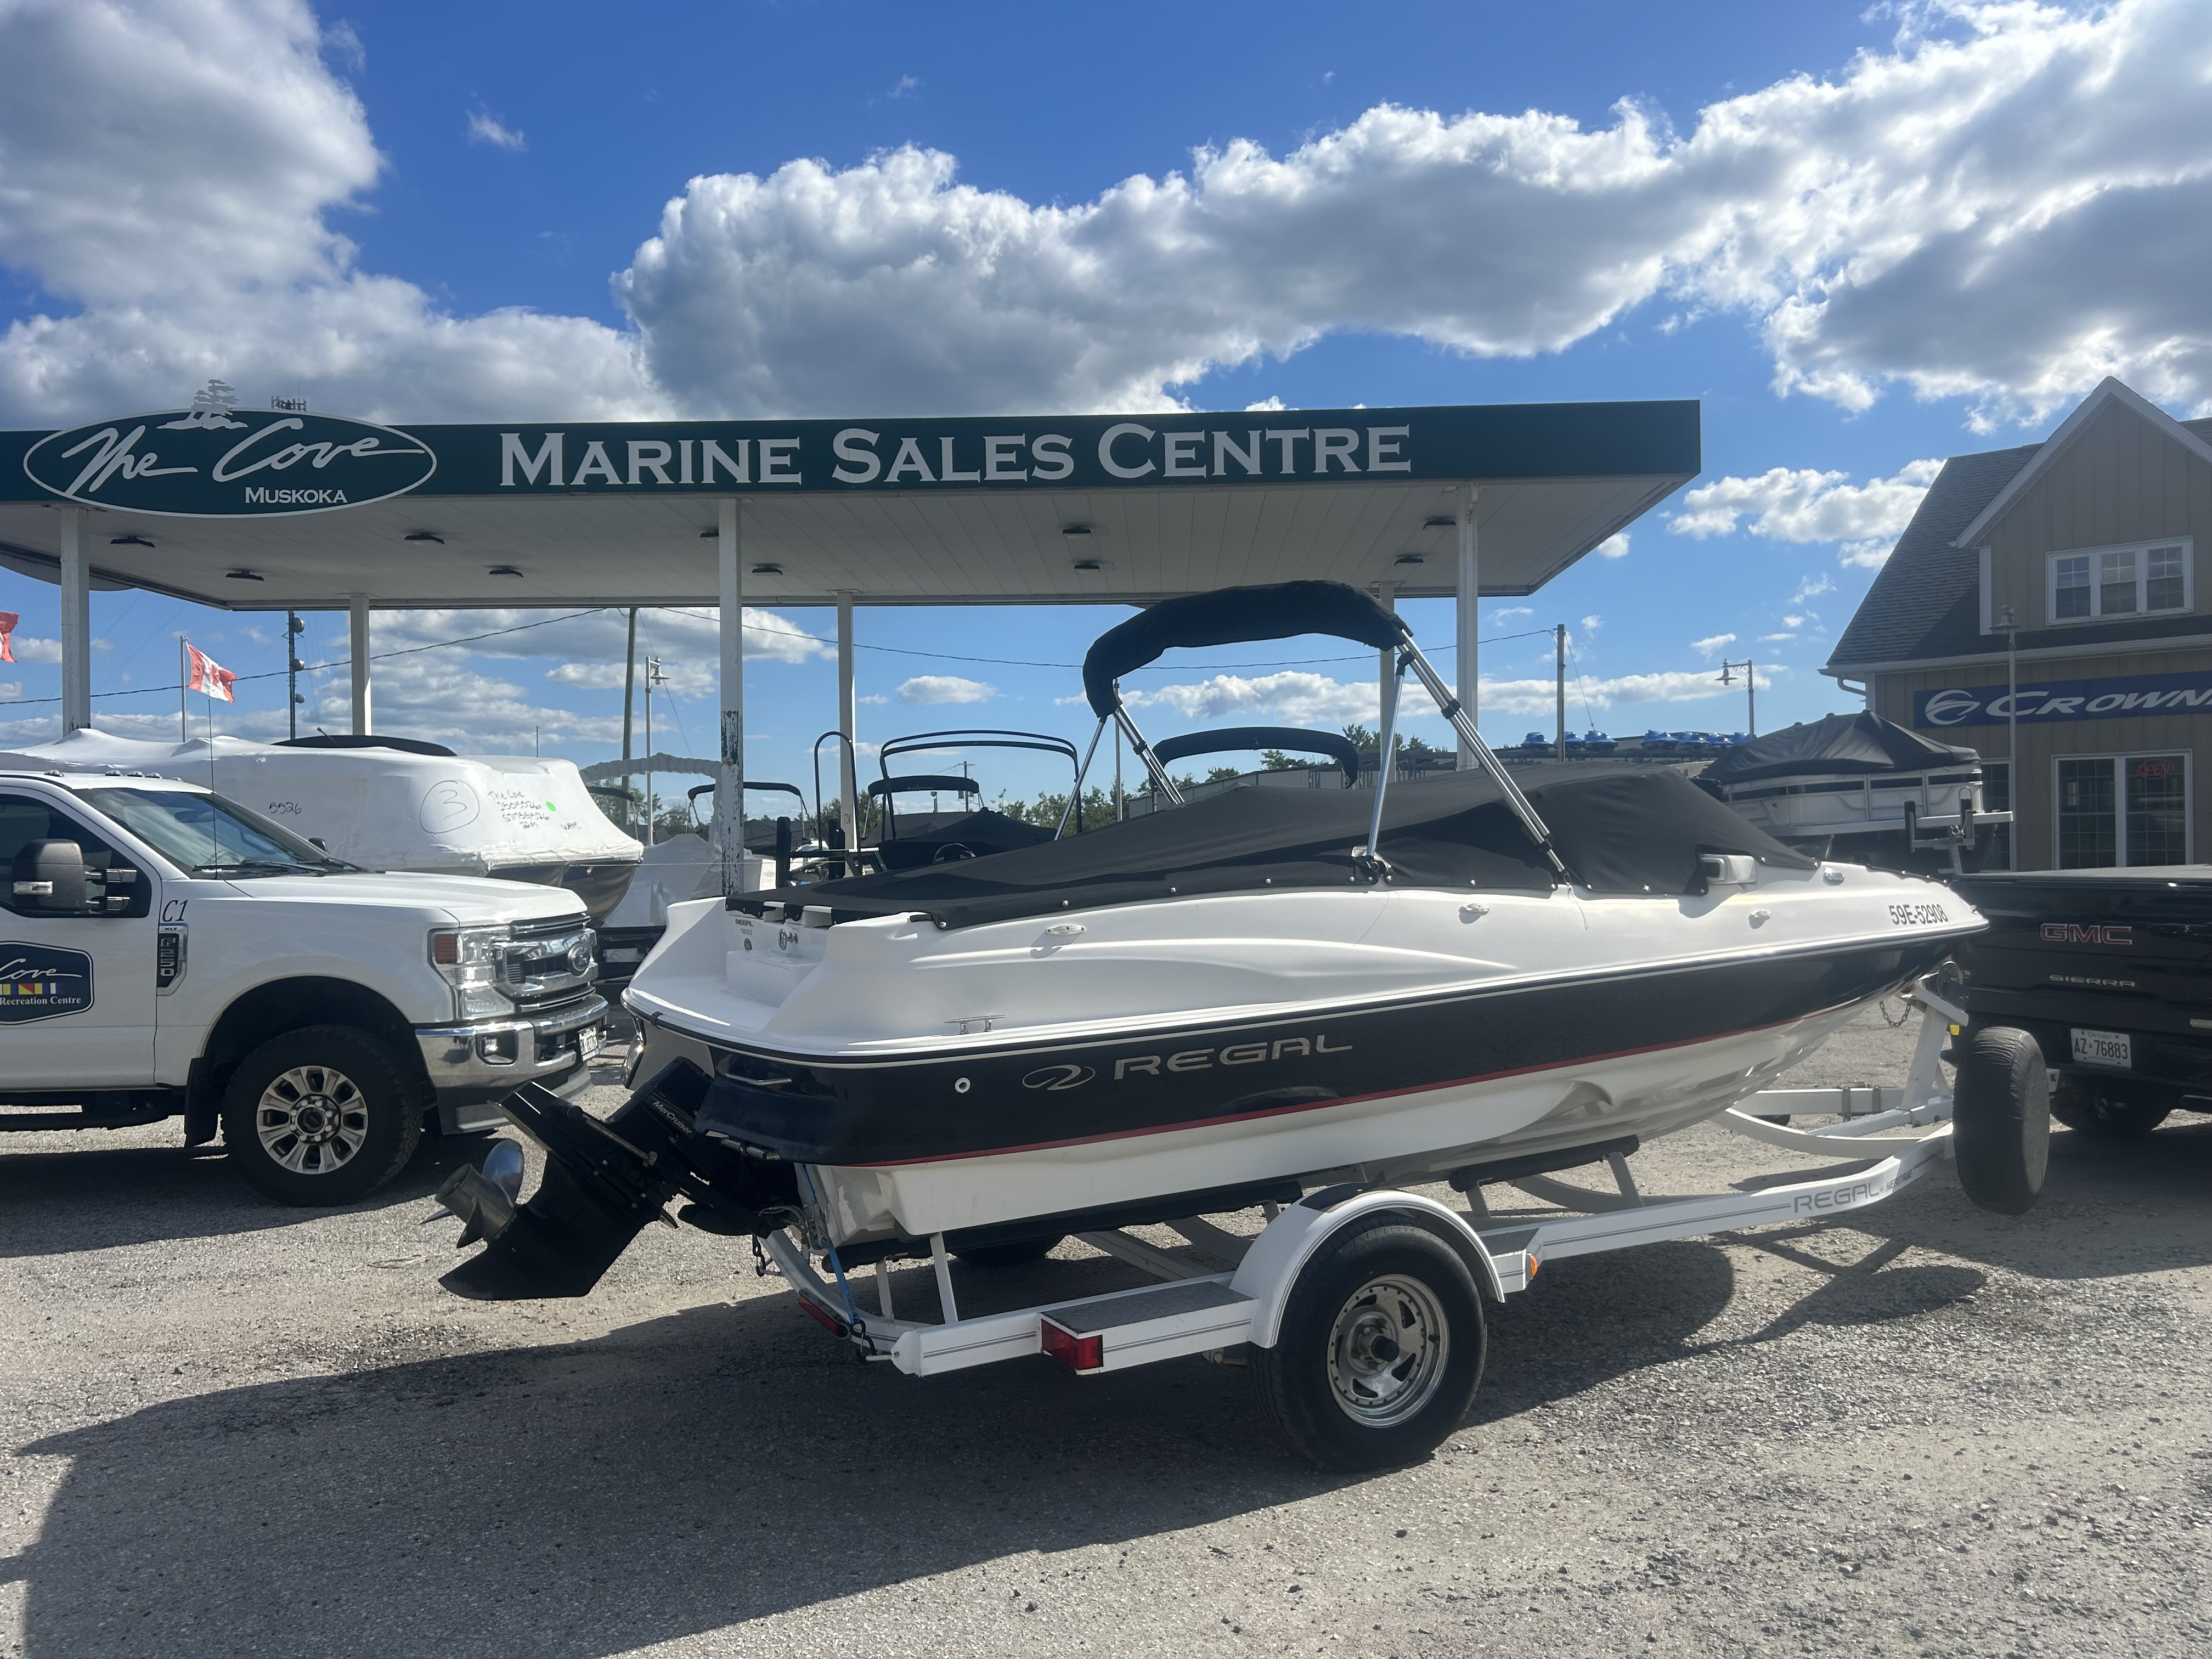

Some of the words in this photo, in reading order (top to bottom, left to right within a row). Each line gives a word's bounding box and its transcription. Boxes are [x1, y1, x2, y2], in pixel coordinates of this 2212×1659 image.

[61, 425, 198, 495] The
[212, 418, 425, 482] Cove
[500, 432, 802, 487] MARINE
[832, 428, 1075, 484] SALES
[1098, 423, 1411, 479] CENTRE
[245, 487, 348, 504] MUSKOKA
[2138, 764, 2171, 775] OPEN
[269, 802, 302, 816] 5526
[439, 789, 467, 823] 3
[162, 899, 188, 922] C1
[1888, 904, 1948, 925] 59E-52908
[735, 918, 754, 927] REGAL
[2040, 923, 2133, 945] GMC
[2049, 974, 2136, 988] SIERRA
[0, 997, 47, 1006] Recreation
[50, 996, 81, 1005] Centre
[1114, 1035, 1353, 1080] REGAL
[652, 1101, 692, 1134] MerCruiser
[1794, 1182, 1879, 1213] REGAL
